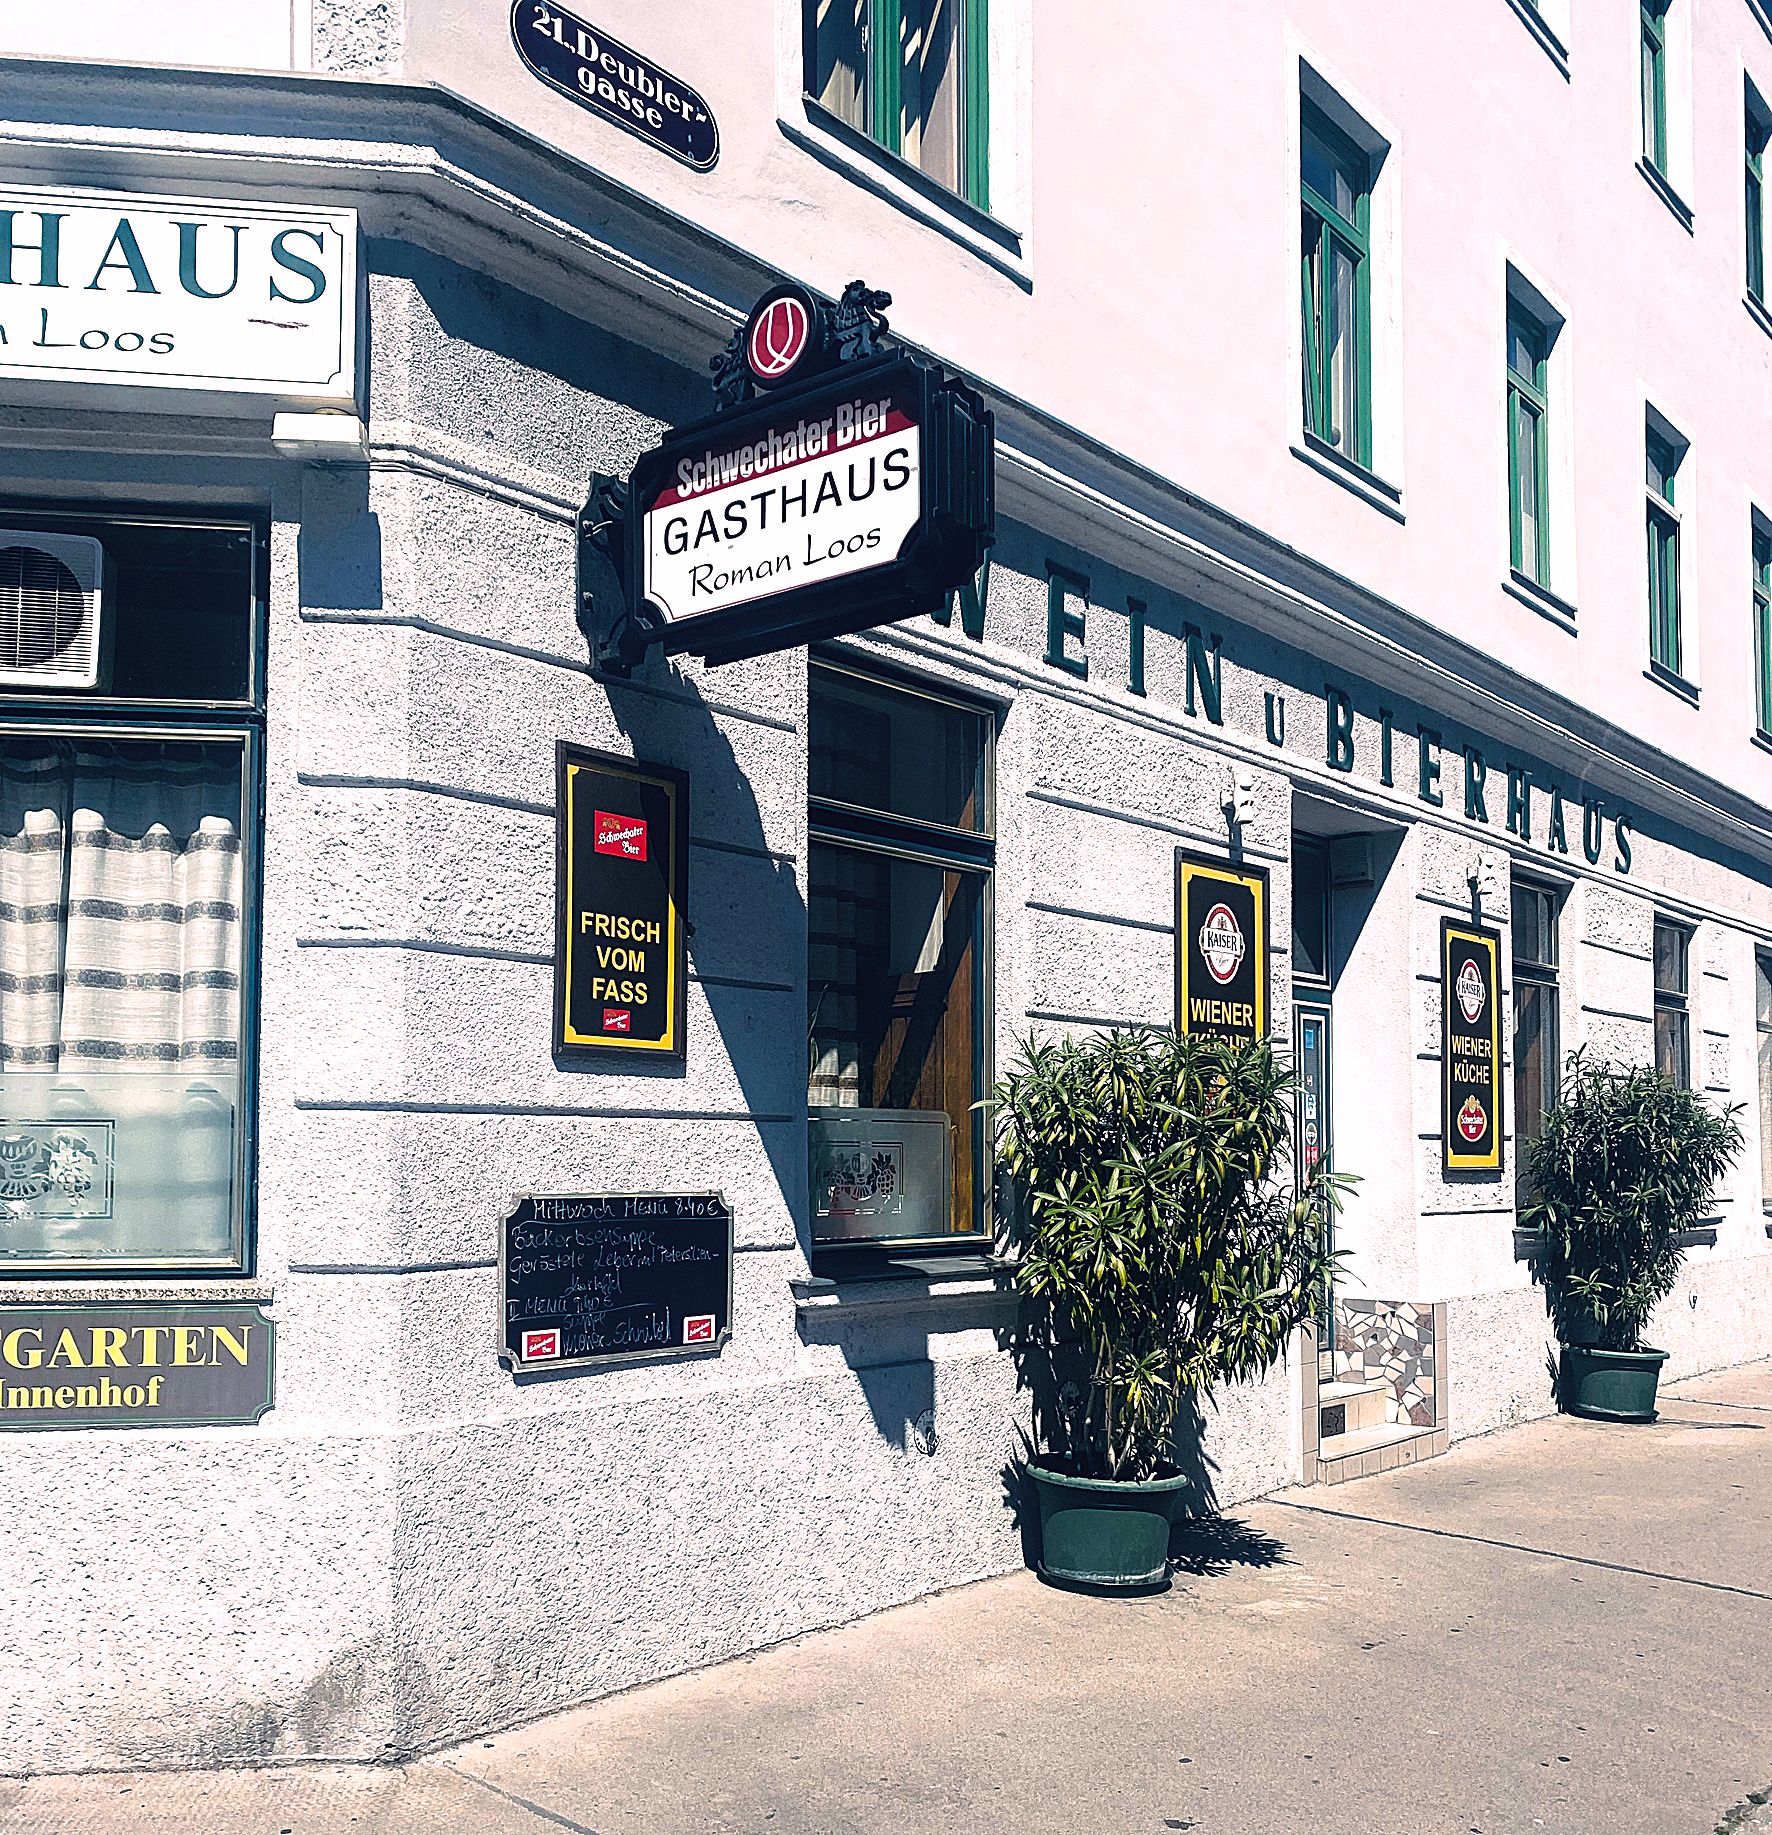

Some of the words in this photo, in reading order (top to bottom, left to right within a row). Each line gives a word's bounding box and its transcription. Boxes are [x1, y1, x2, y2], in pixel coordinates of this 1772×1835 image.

[577, 66, 663, 129] gasse
[32, 307, 175, 354] Loos
[676, 414, 834, 499] Schwechater
[835, 397, 892, 448] Bier
[662, 447, 912, 556] GASTHAUS
[688, 554, 792, 597] Roman
[802, 527, 882, 566] Loos
[1324, 683, 1634, 875] BIERHAUS
[581, 911, 660, 944] FRISCH
[1207, 930, 1238, 952] KAISER
[596, 945, 645, 973] VOM
[592, 977, 648, 1006] FASS
[1190, 997, 1254, 1028] WIENER
[1451, 1034, 1492, 1059] WIENER
[1454, 1059, 1490, 1085] KÜCHE
[533, 1197, 616, 1220] Mittwoch
[0, 1324, 253, 1370] GARTEN
